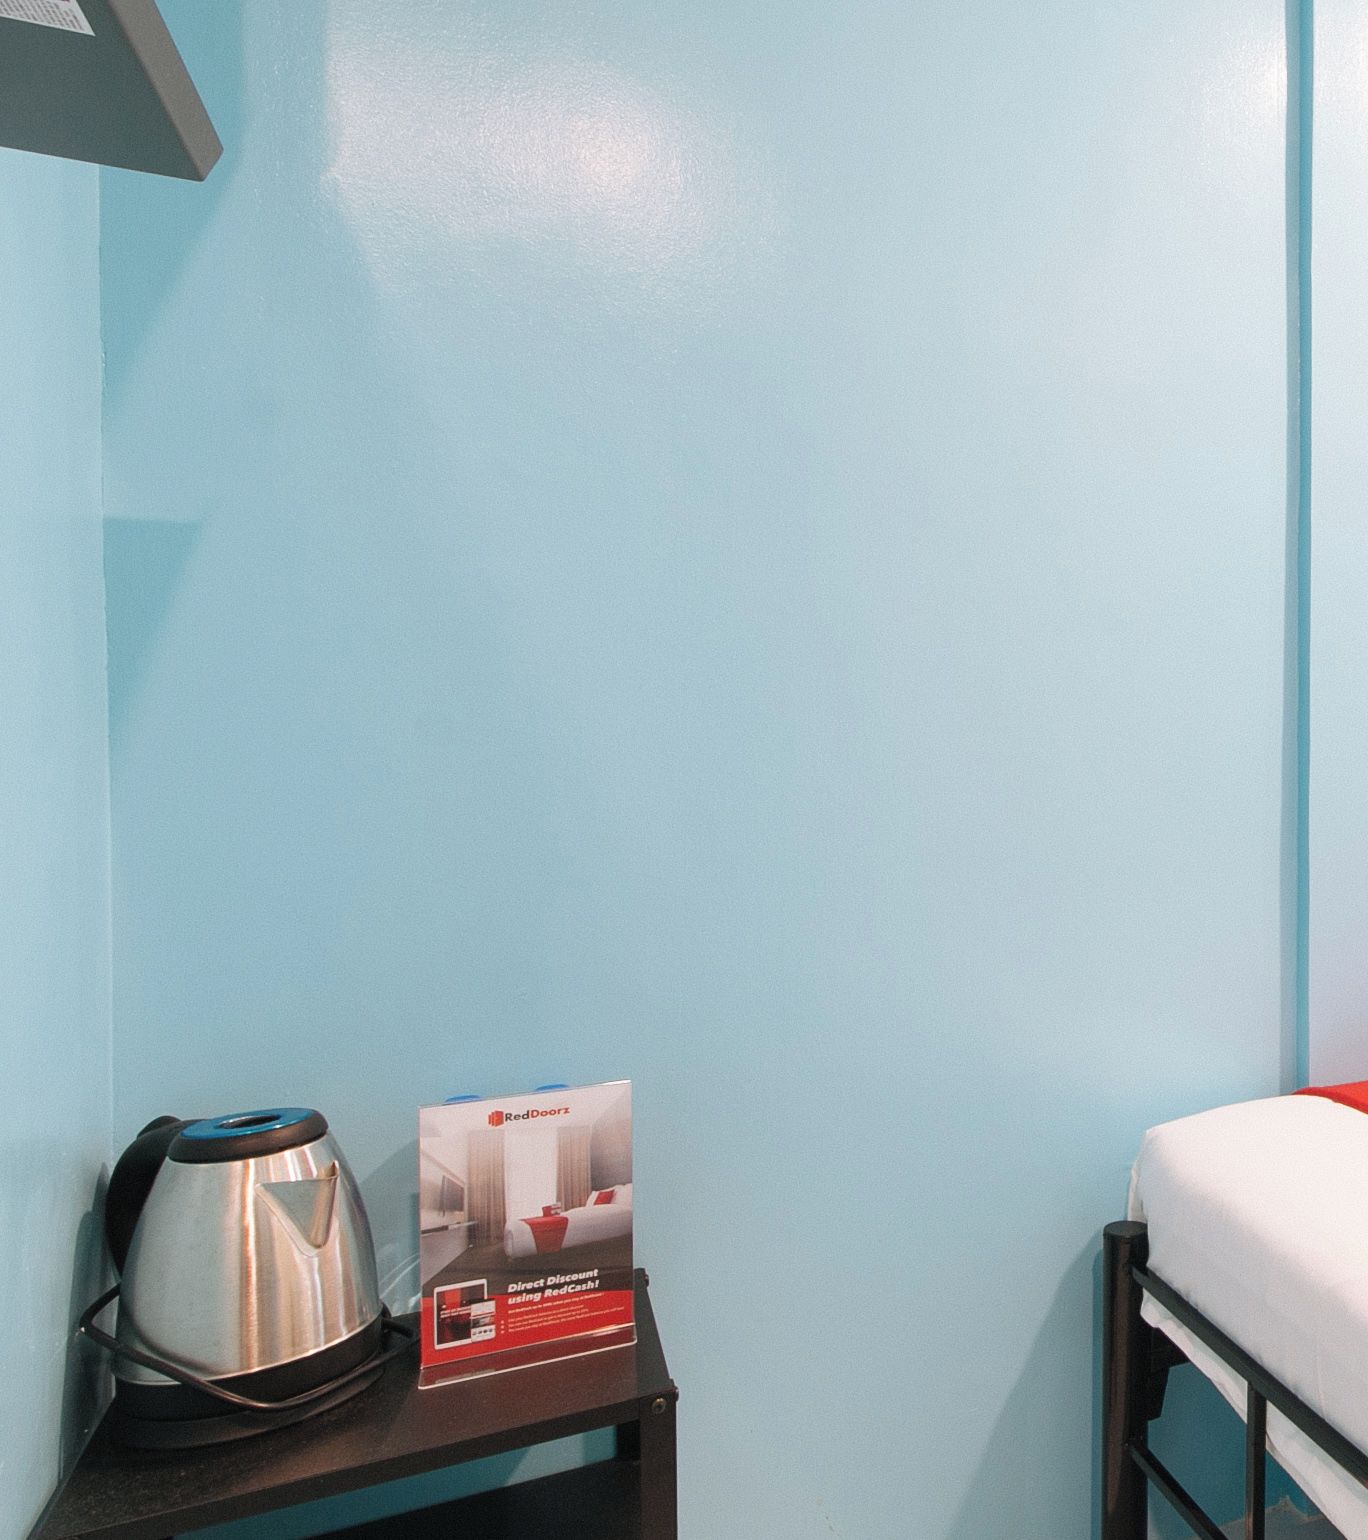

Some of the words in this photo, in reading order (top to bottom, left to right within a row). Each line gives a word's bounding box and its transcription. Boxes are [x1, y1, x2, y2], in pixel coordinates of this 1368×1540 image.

[504, 1107, 570, 1122] RedDoorz
[507, 1279, 545, 1293] Direct
[546, 1269, 599, 1286] Discount
[507, 1291, 542, 1305] using
[543, 1280, 600, 1298] RedCash!
